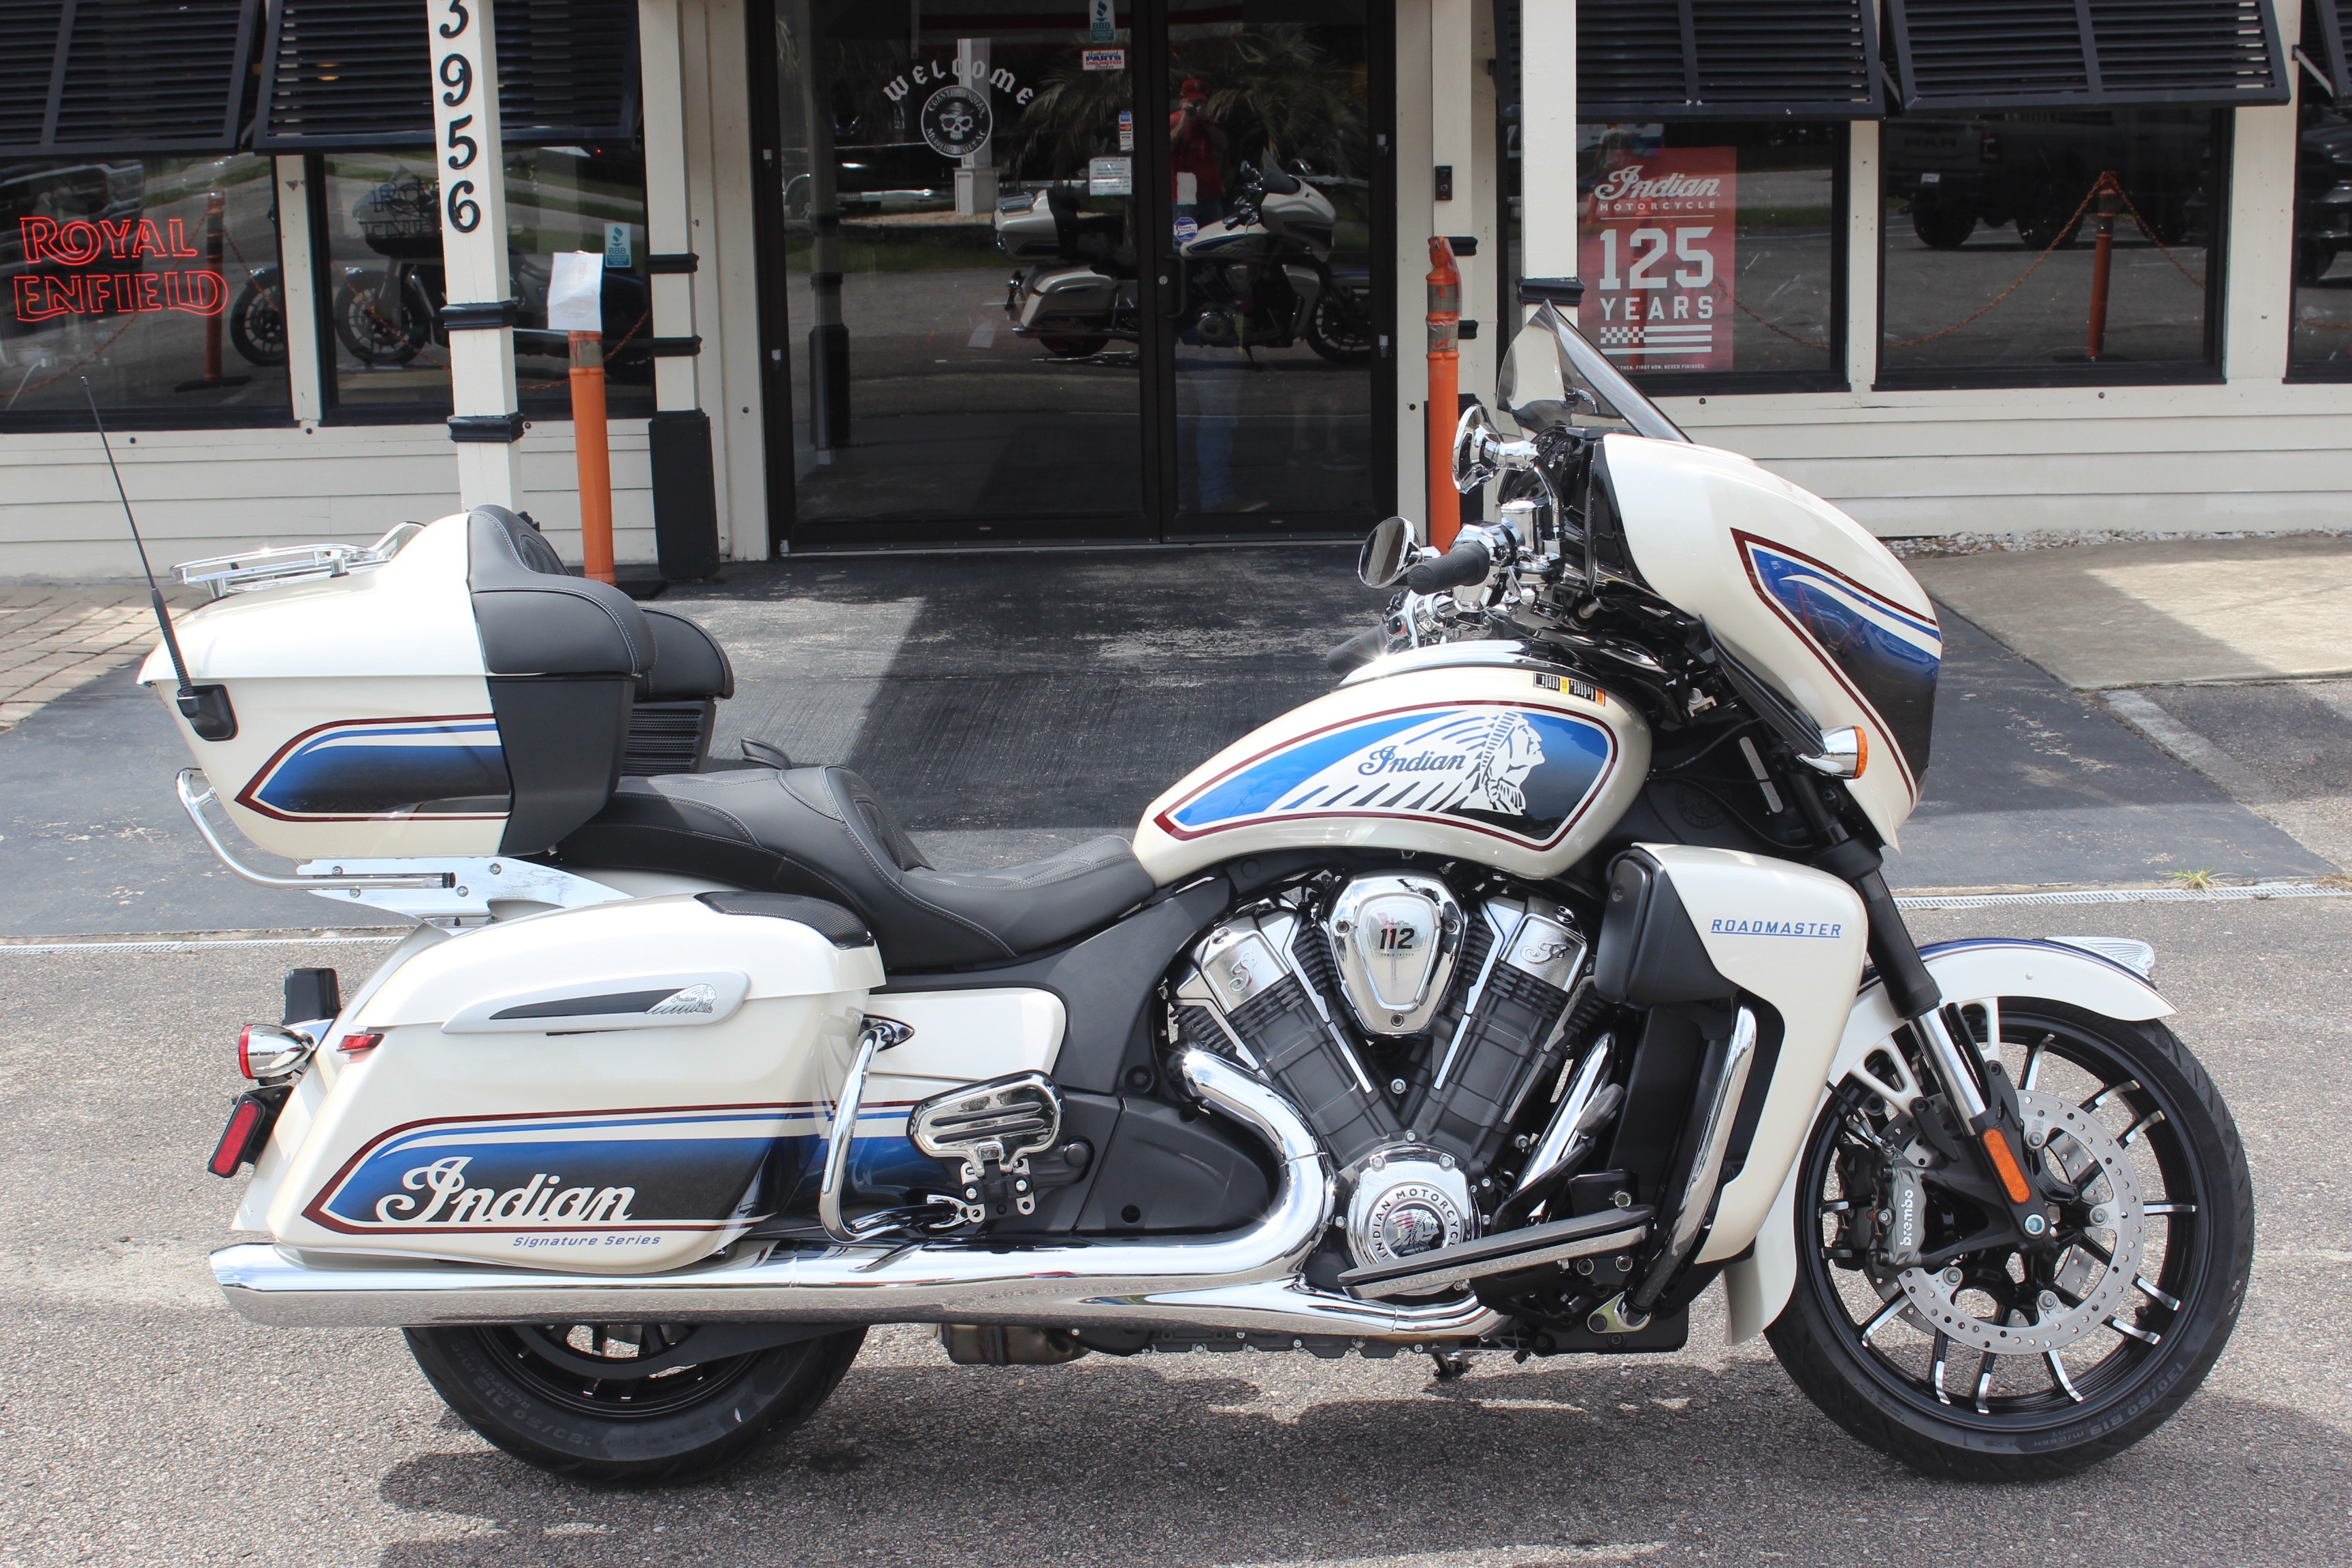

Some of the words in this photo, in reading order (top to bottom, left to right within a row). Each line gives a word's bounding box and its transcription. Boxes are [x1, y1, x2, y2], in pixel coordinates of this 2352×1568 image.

[883, 58, 1033, 105] WELCOME
[1595, 165, 1720, 200] Indian
[1600, 201, 1715, 211] MOTORCYCLE
[20, 216, 197, 265] ROYAL
[1600, 227, 1714, 290] 125
[14, 271, 228, 321] ENFIELD
[1600, 296, 1713, 321] YEARS
[1358, 745, 1466, 776] Indian
[1380, 928, 1414, 949] 112
[1711, 919, 1841, 936] ROADMASTER
[671, 994, 697, 1002] Indian
[376, 1157, 636, 1222] Indian
[1373, 1201, 1391, 1258] INDIAN
[1396, 1188, 1458, 1247] MOTORCYCL
[1899, 1190, 1913, 1246] brembo
[513, 1237, 598, 1248] Signature
[604, 1235, 661, 1246] Series
